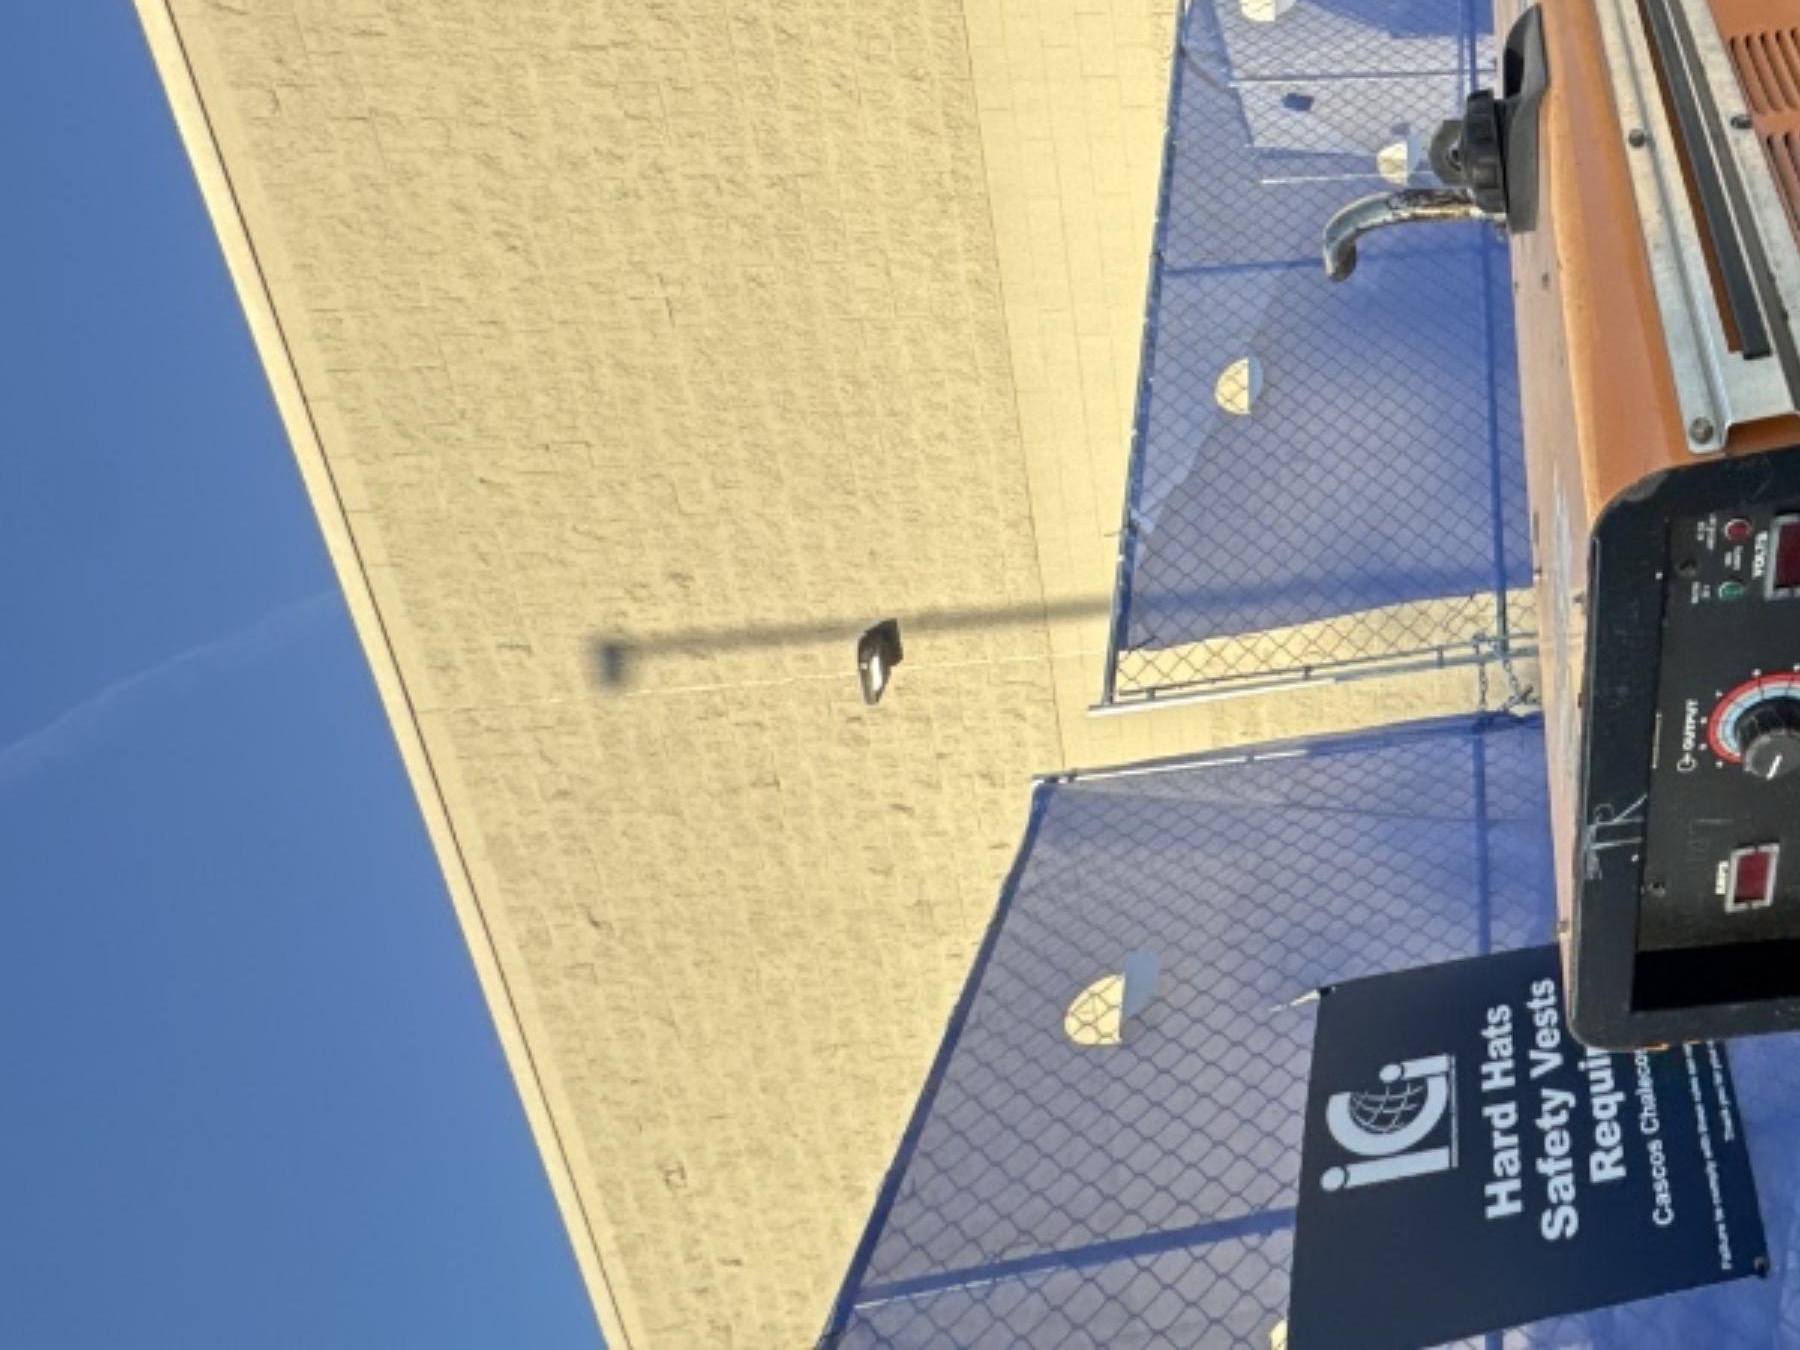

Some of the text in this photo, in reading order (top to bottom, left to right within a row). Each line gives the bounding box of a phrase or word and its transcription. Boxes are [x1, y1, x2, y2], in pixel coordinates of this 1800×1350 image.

[1479, 1004, 1524, 1219] Hard Hats
[1525, 978, 1580, 1241] Safety Vests
[1577, 1048, 1627, 1184] Requir
[1646, 1140, 1675, 1226] Cascos
